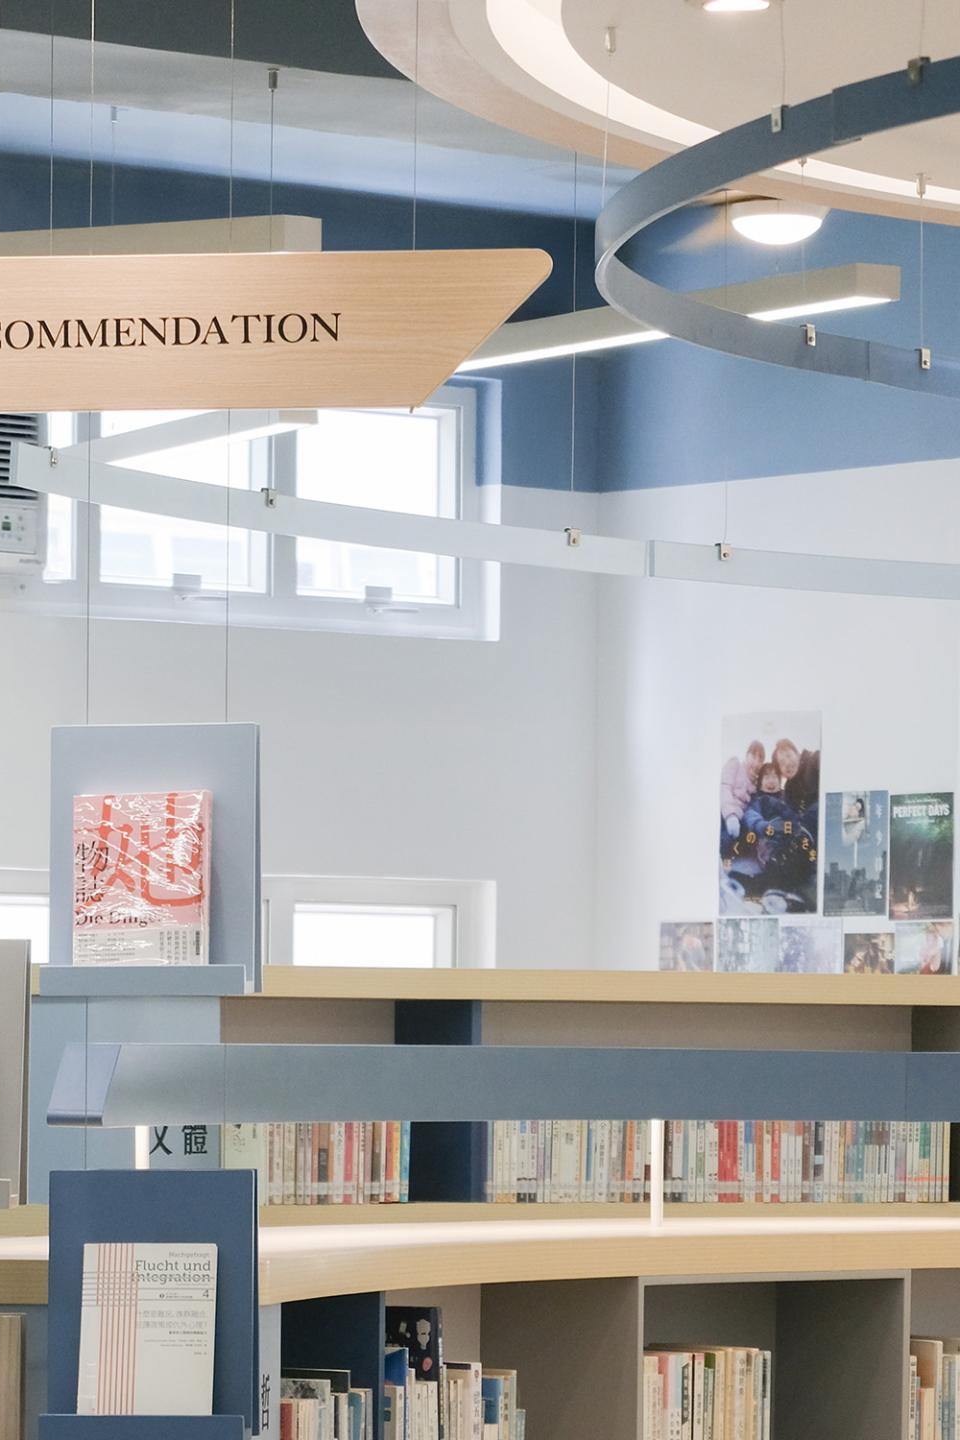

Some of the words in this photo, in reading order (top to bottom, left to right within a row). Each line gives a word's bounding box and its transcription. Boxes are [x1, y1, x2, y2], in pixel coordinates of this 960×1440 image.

[893, 805, 926, 818] PERFECT
[928, 804, 951, 817] DAYS
[135, 1260, 180, 1272] Flucht
[183, 1260, 211, 1272] und
[131, 1271, 211, 1286] Integration
[202, 1289, 210, 1298] 4
